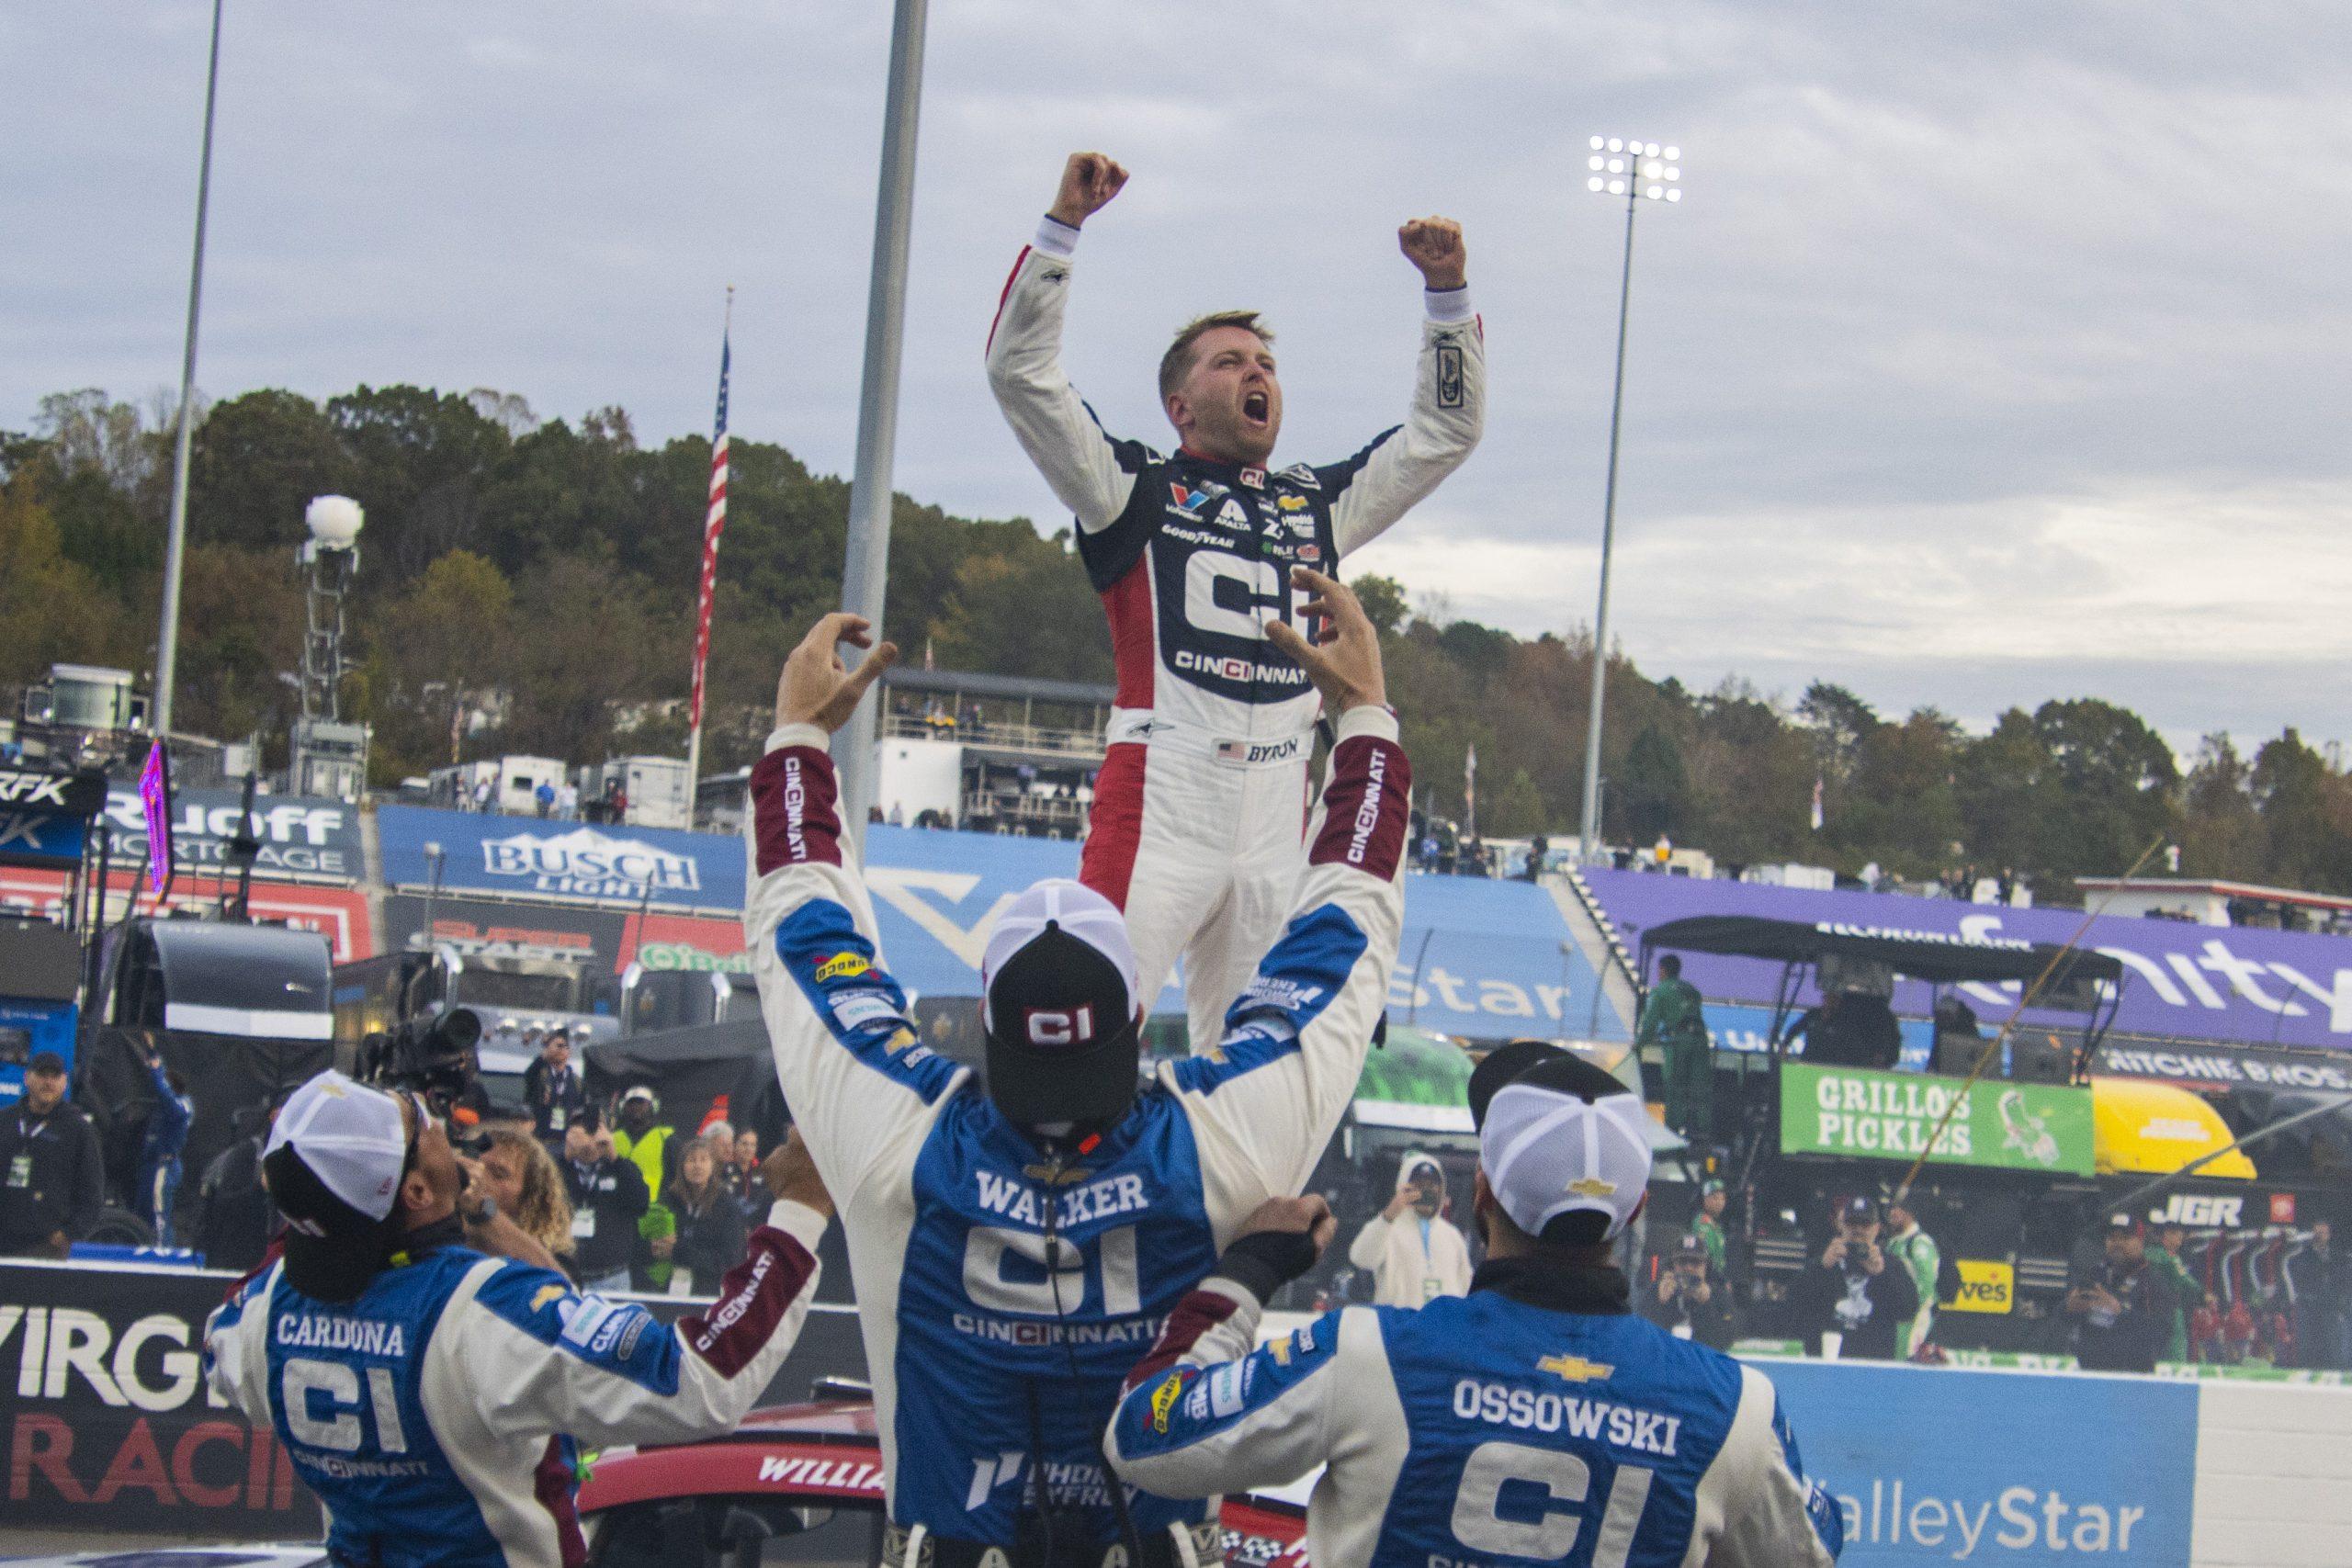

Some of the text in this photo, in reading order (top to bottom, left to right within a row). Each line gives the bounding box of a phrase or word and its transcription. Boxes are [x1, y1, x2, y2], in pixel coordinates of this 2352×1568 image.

[1161, 524, 1236, 549] GOODYEAR
[1185, 549, 1309, 645] CI
[1175, 650, 1307, 683] CINCINNAT
[1248, 739, 1298, 762] BYRON
[786, 757, 806, 861] CINCINNATI
[1347, 748, 1386, 863] CINCINNATI
[481, 838, 700, 891] BUSCH
[535, 876, 648, 898] LIGHT
[1028, 1007, 1091, 1044] CI
[2101, 1049, 2243, 1080] RITCHIE
[1817, 1076, 1971, 1120] GRILLO'S
[1817, 1112, 1972, 1156] PICKLES
[976, 1169, 1149, 1228] WALKER
[2148, 1195, 2245, 1227] JGR
[963, 1224, 1141, 1316] CI
[0, 1305, 229, 1413] IRG
[277, 1314, 404, 1357] CARDONA
[282, 1357, 408, 1453] CI
[1453, 1380, 1681, 1457] OSSOWSKI
[758, 1455, 886, 1491] WILLIA
[1450, 1441, 1654, 1568] CI
[1818, 1478, 2145, 1562] alleyStar
